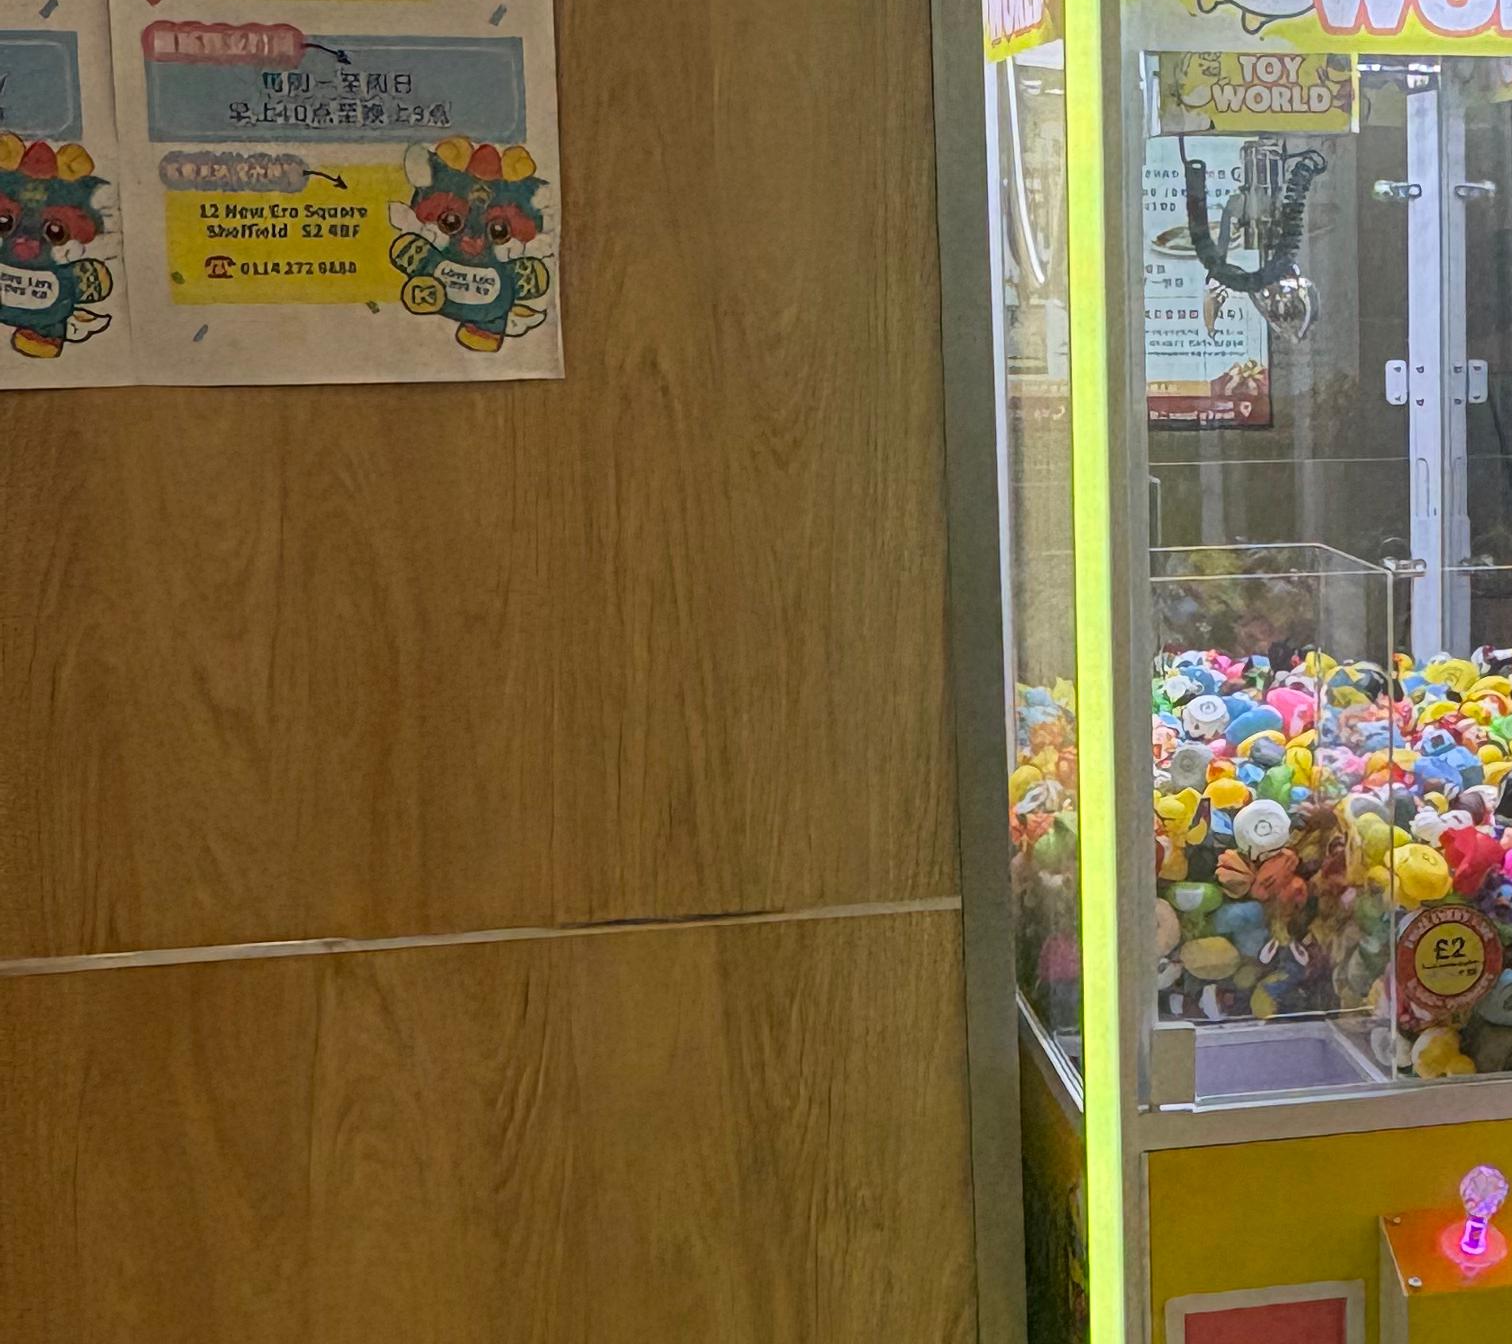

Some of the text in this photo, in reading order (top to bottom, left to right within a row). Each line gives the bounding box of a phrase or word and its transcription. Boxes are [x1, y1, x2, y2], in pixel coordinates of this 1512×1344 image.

[1236, 55, 1305, 85] TOY
[1210, 83, 1334, 114] WORLD
[1434, 936, 1467, 961] £2
